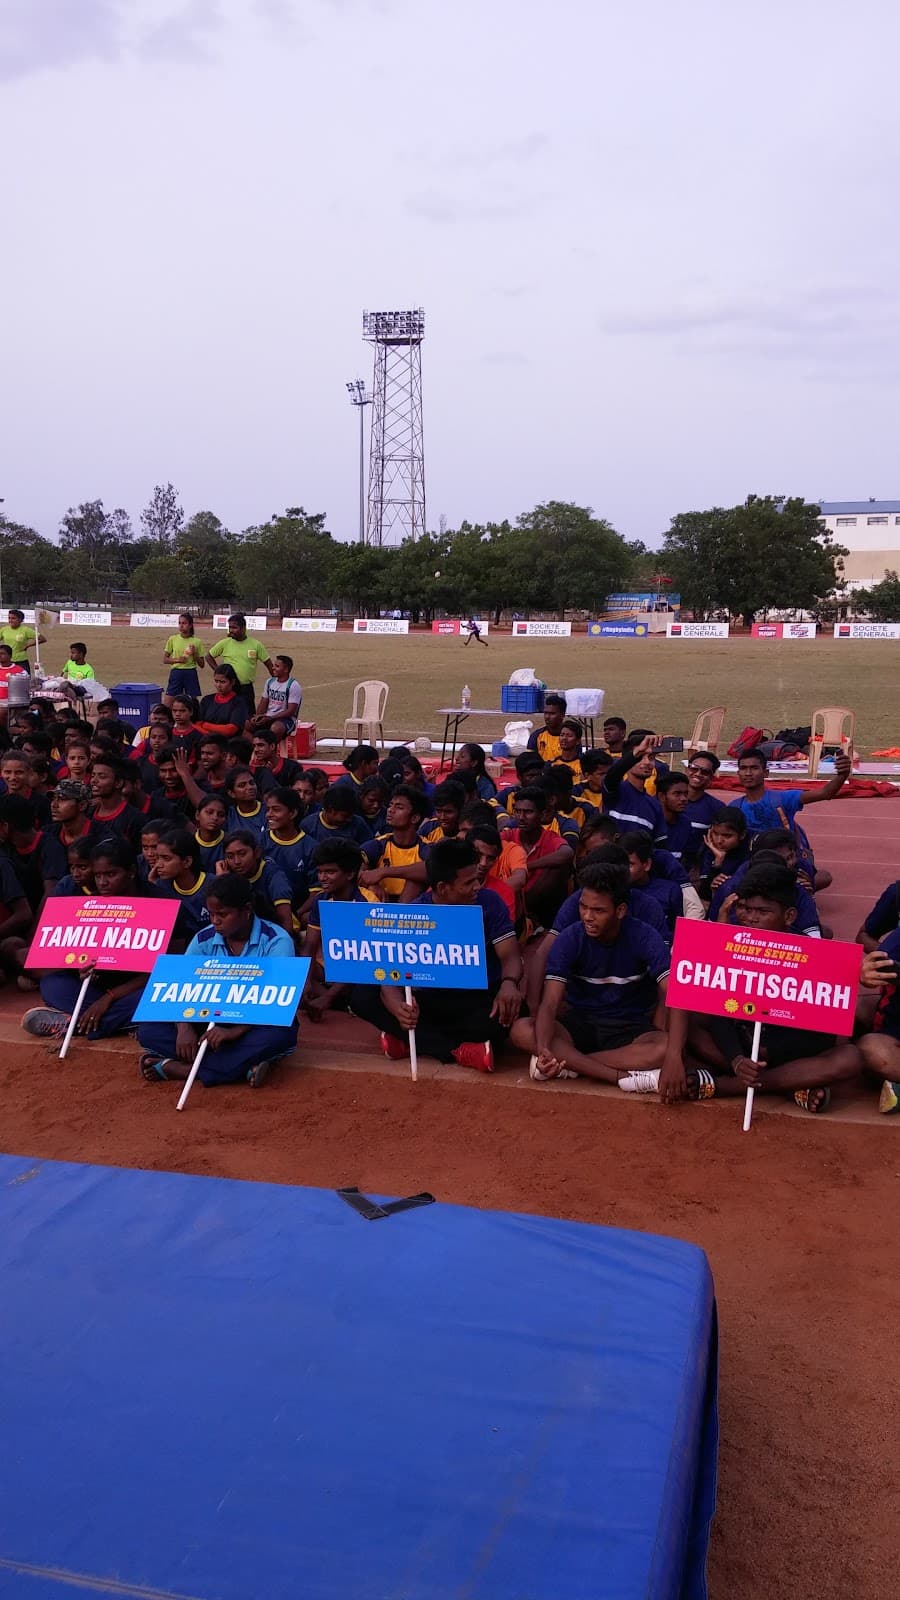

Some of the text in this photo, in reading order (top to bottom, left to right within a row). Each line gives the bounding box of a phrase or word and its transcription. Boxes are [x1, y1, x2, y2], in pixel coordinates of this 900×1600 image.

[76, 909, 136, 919] RUGBY SEVENS
[398, 913, 430, 921] NATIONAL
[364, 918, 437, 929] RUGBY SEVENS
[39, 926, 165, 951] TAMIL NADU
[328, 938, 480, 967] CHATTISGARH
[725, 941, 809, 963] RUGBY SEVENS
[767, 942, 802, 953] NATIONAL
[194, 967, 264, 977] RUGBY SEVENS
[676, 960, 851, 1010] CHATTISGARH
[150, 982, 296, 1007] TAMIL NADU
